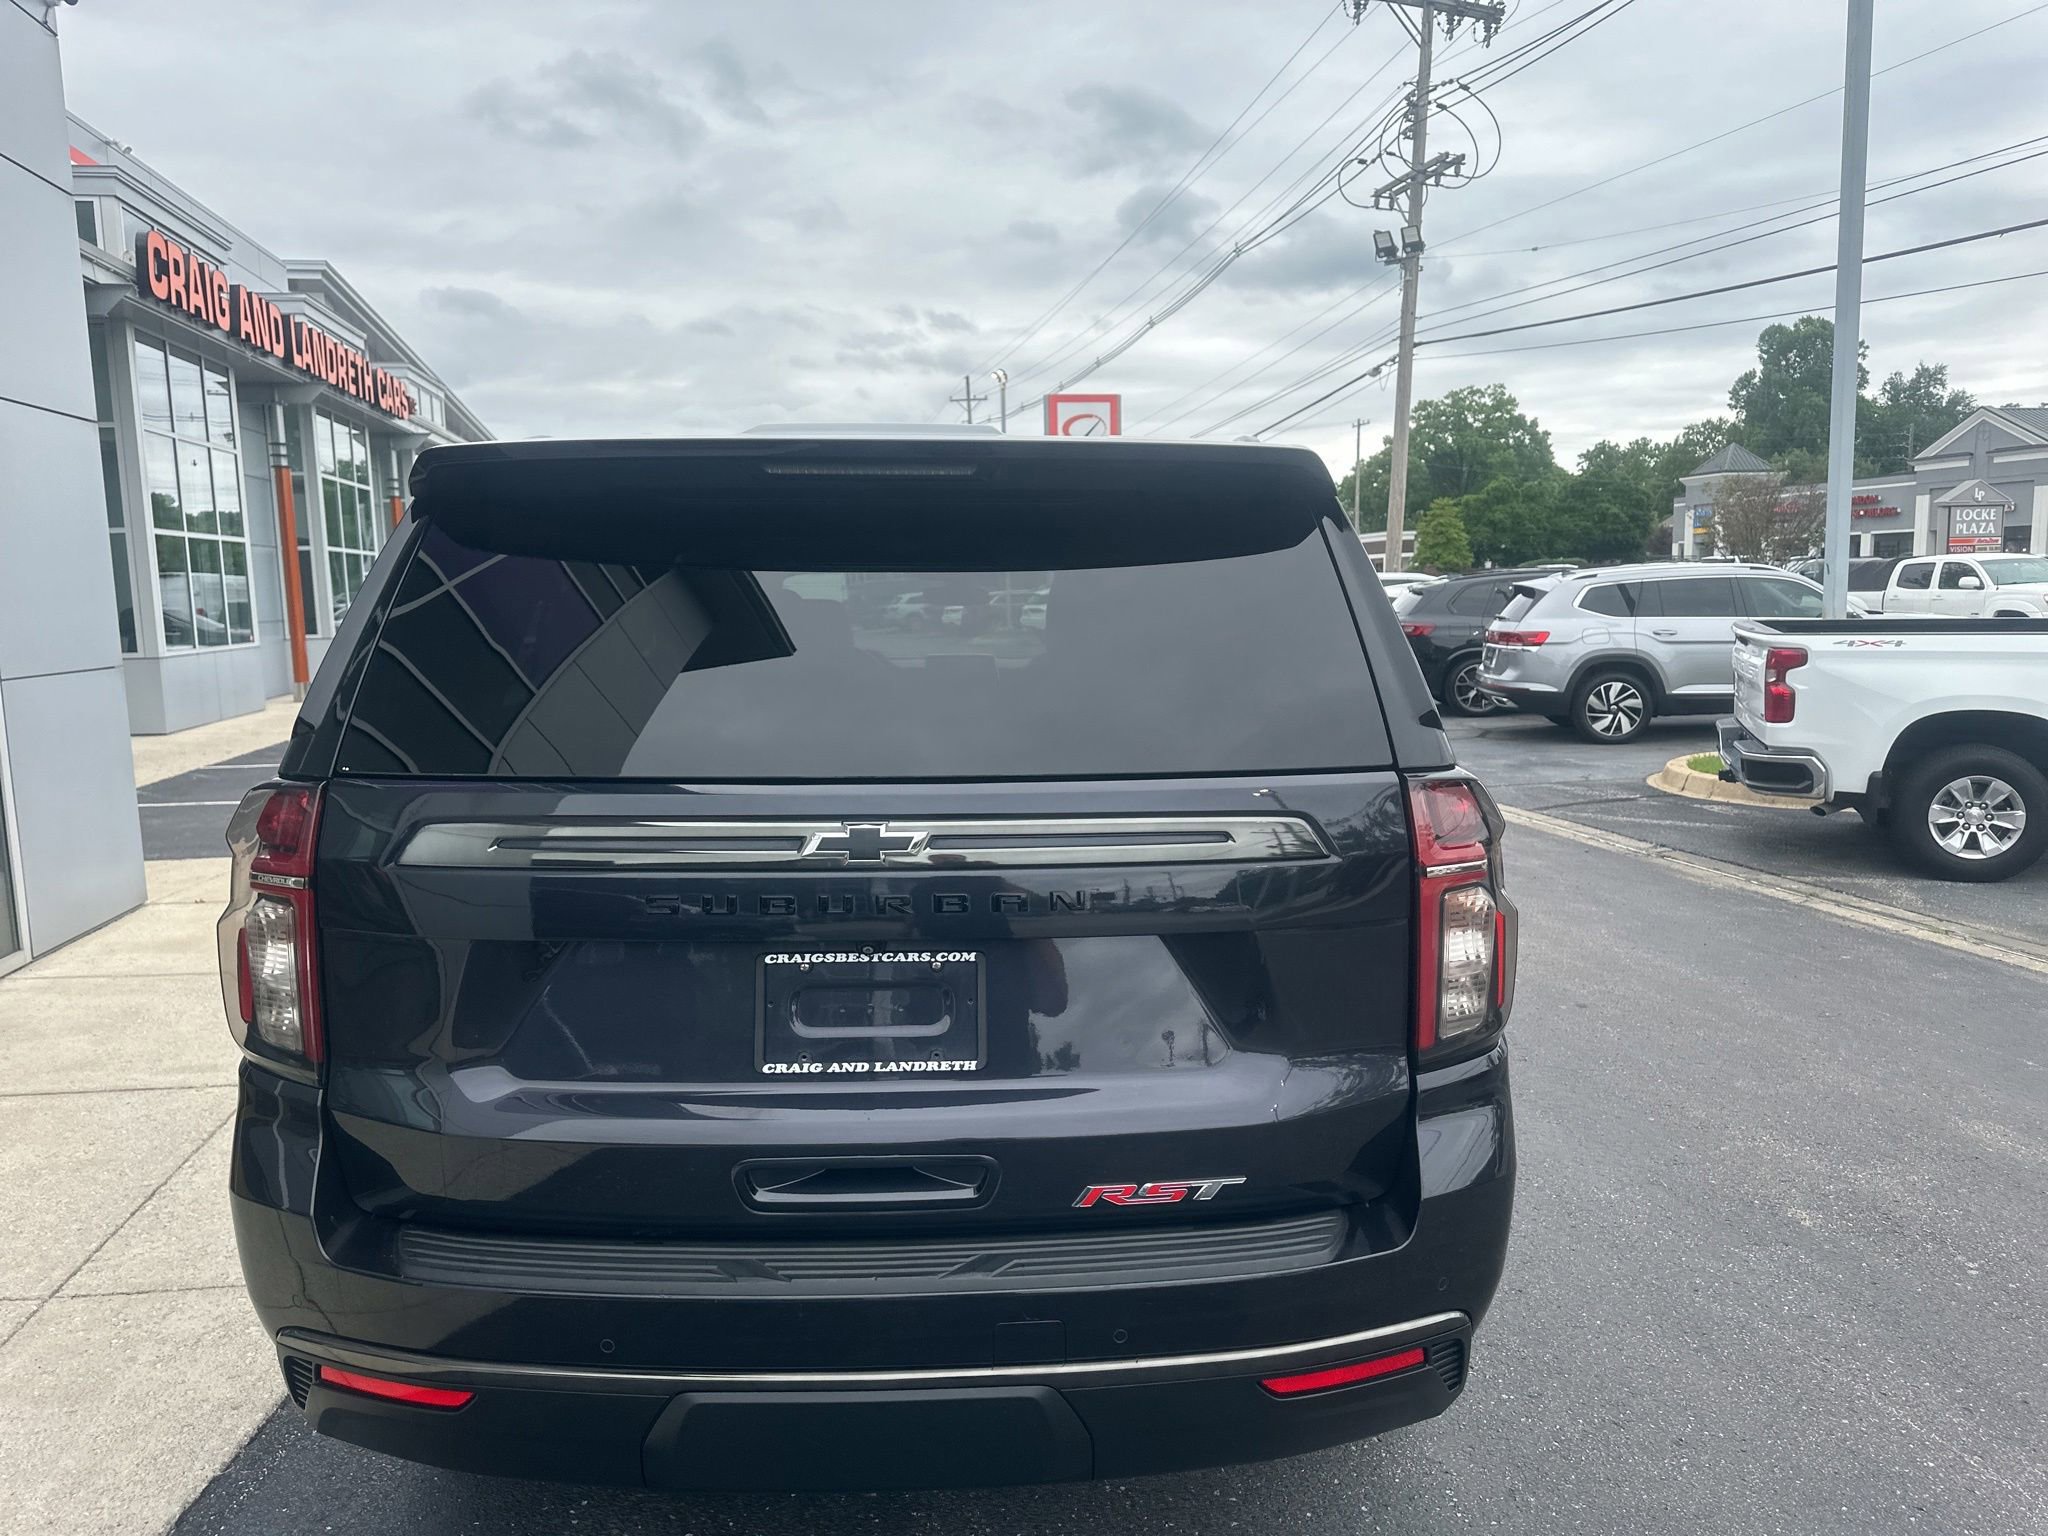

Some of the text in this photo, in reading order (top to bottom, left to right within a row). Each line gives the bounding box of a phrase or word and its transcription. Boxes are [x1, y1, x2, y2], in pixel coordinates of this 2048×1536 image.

[145, 230, 410, 420] CRAIG AND LANDRETH CARS
[1956, 508, 1997, 521] LOCKE
[1956, 522, 1995, 534] PLAZA
[1950, 545, 1974, 553] VISION
[645, 890, 1086, 915] SUBURBAN
[764, 952, 977, 964] CRAIGSBESTCARS.COM
[762, 1061, 978, 1074] CRAIG AND LANDRETH
[1071, 1176, 1248, 1208] RST
